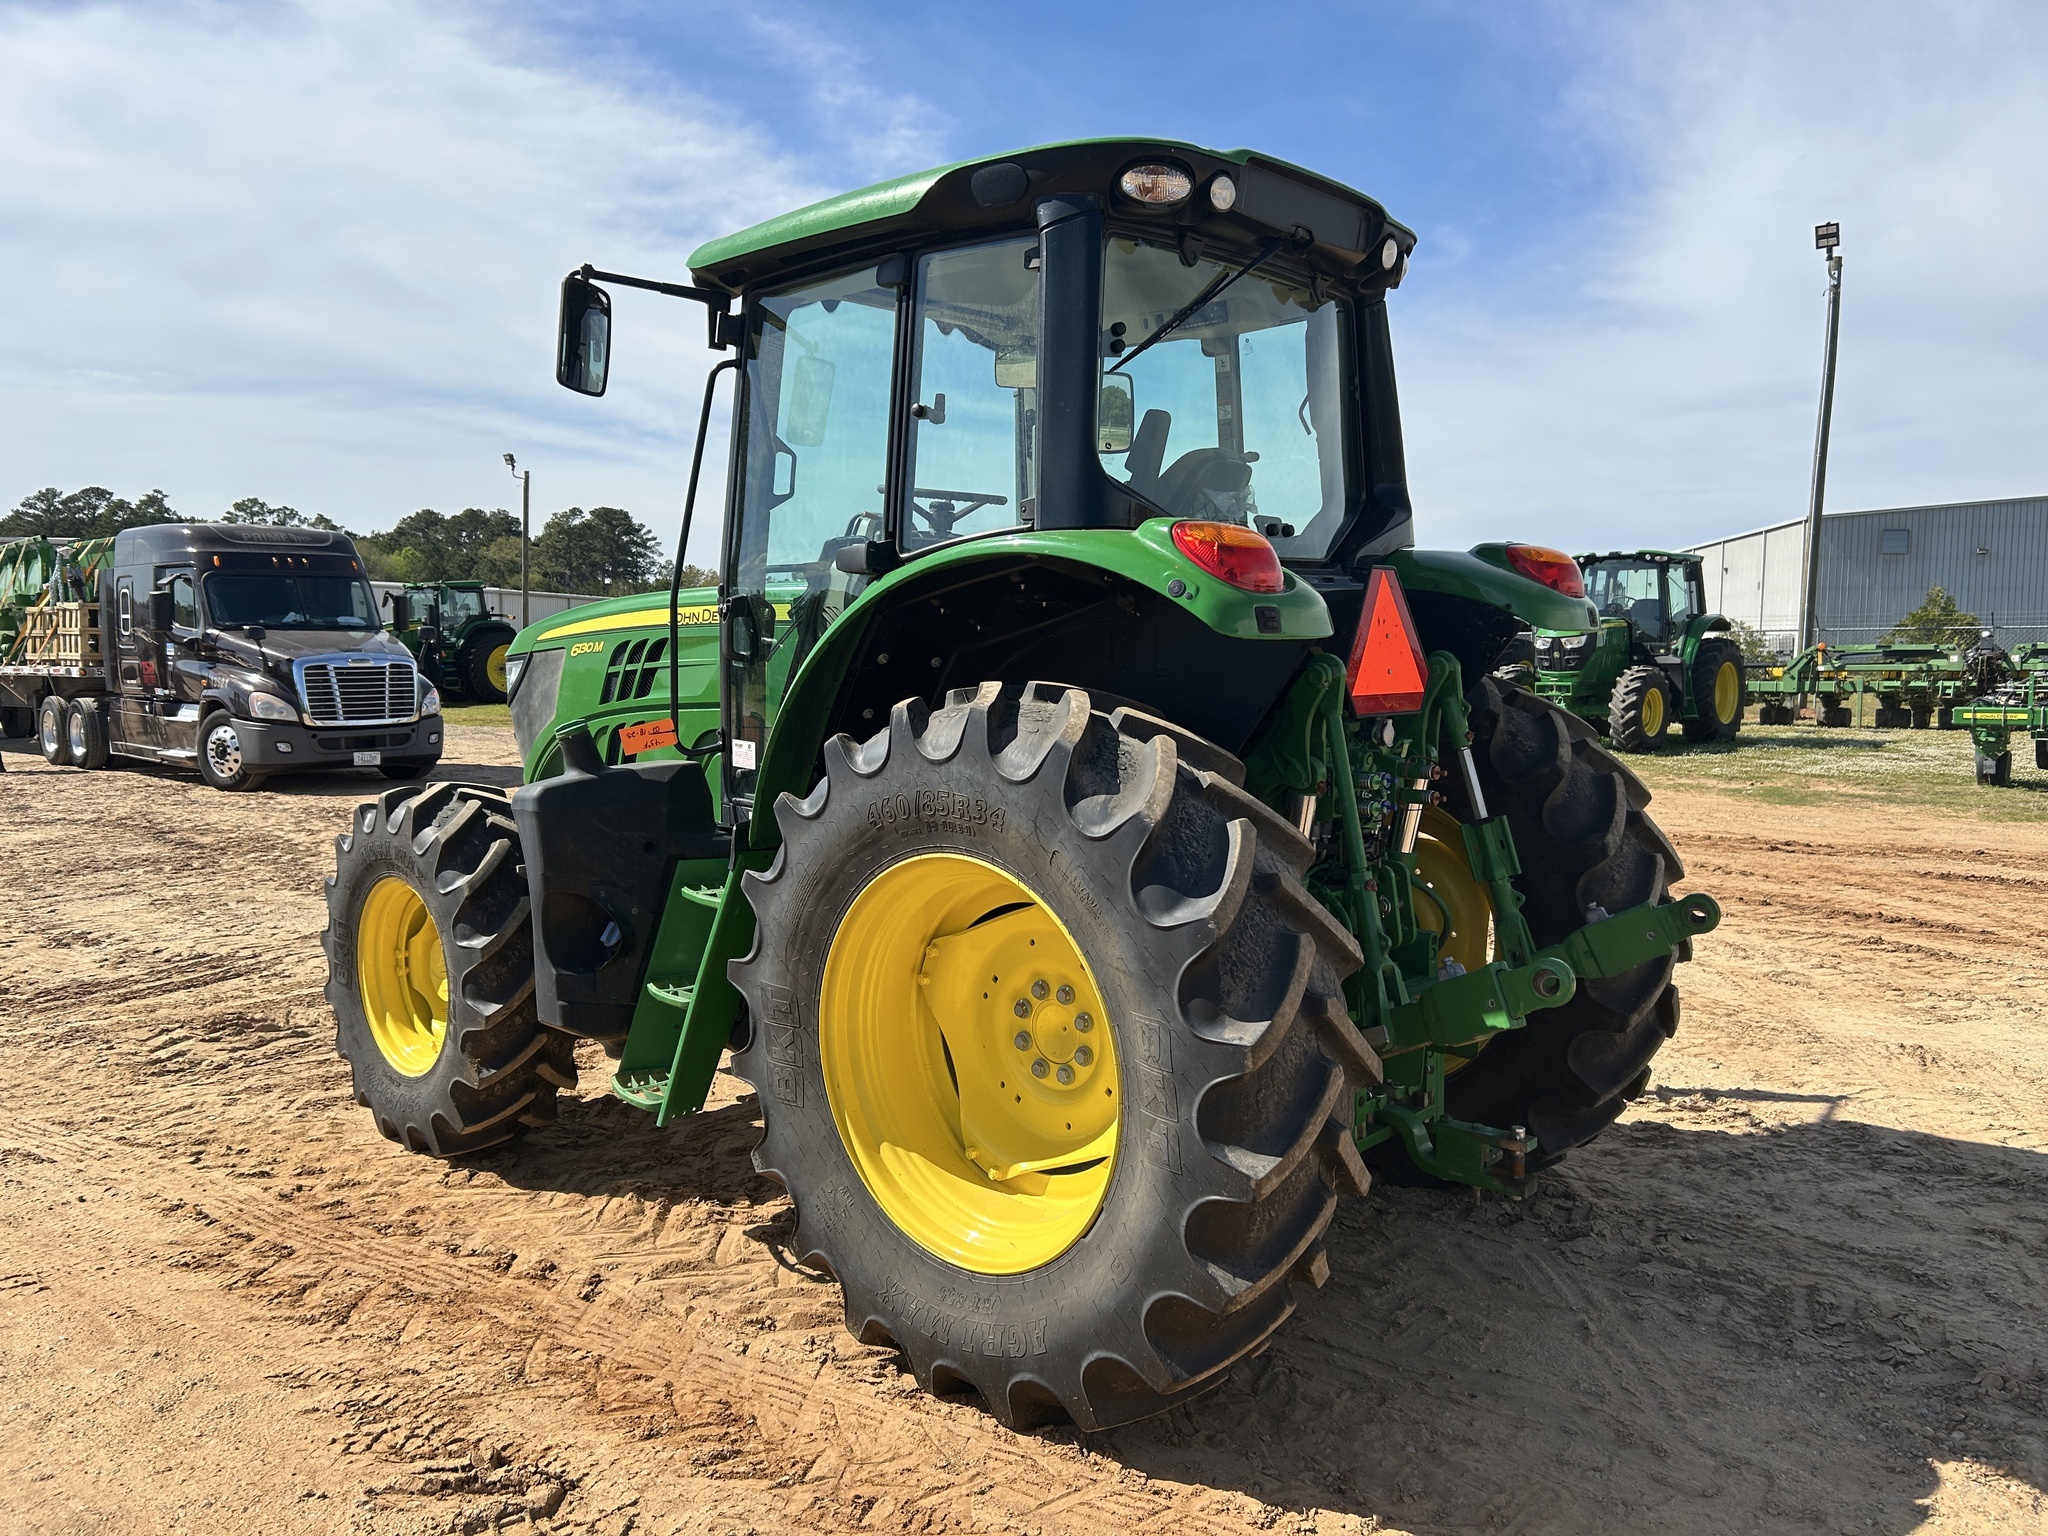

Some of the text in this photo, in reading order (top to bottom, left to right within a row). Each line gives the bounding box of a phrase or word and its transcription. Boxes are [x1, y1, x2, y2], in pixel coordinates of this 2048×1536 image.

[241, 531, 289, 542] PRIME
[668, 611, 700, 624] OHN
[570, 640, 605, 657] 6130M
[866, 789, 1008, 834] 460/85R34
[334, 919, 352, 989] BKT
[764, 983, 802, 1106] BKT
[1133, 1013, 1179, 1172] BKT
[875, 1275, 1048, 1359] AGRI MAX
[936, 1285, 968, 1309] 855
